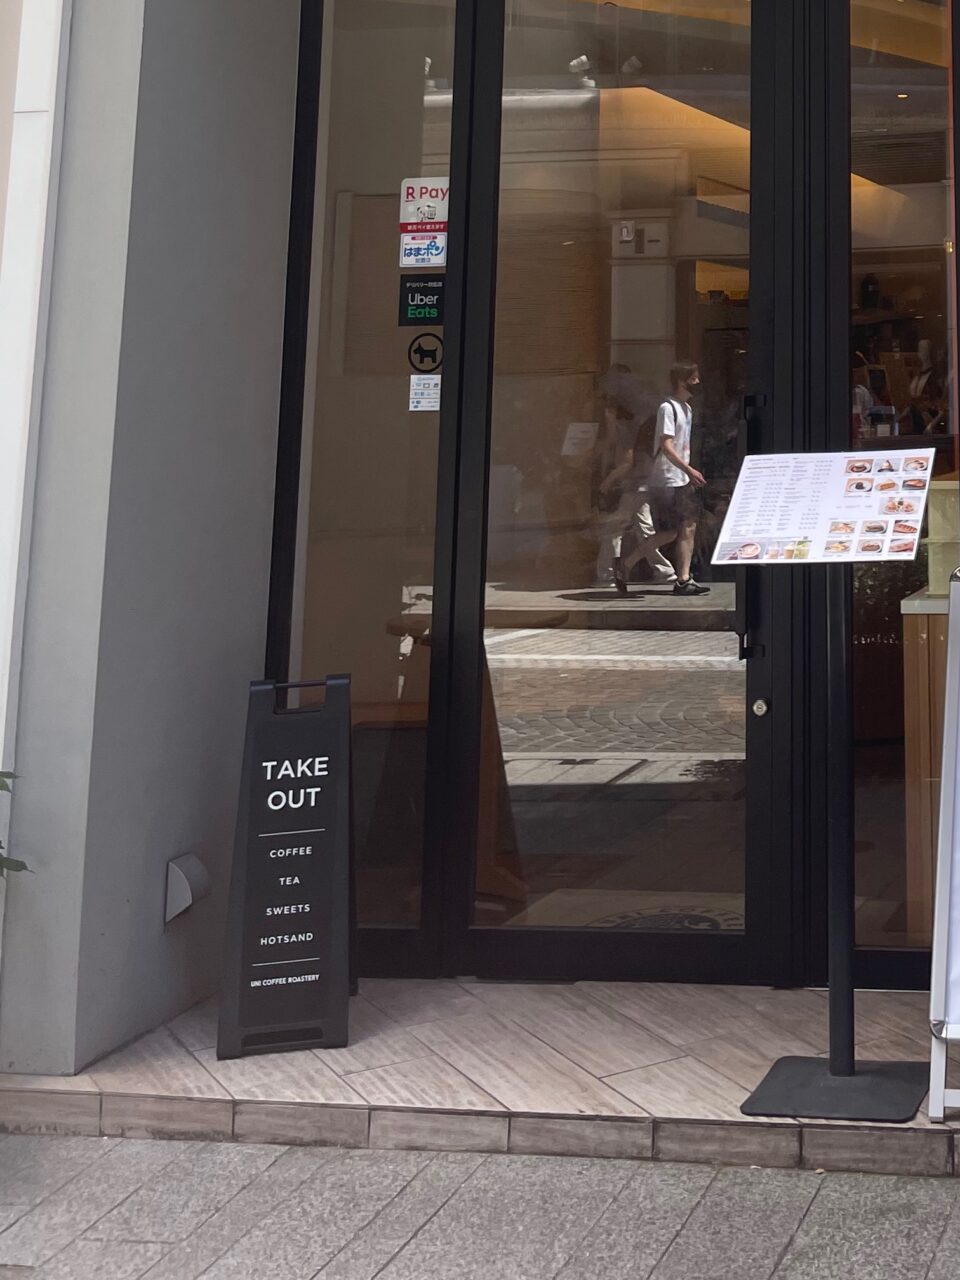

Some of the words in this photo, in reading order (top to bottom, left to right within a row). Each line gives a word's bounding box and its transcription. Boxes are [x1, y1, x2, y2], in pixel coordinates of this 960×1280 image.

[420, 186, 449, 201] Pay
[404, 240, 445, 258] はまポン
[408, 293, 439, 305] Uber
[408, 306, 438, 318] Eats
[262, 756, 329, 780] TAKE
[267, 787, 321, 811] OUT
[269, 846, 313, 858] COFFEE
[279, 876, 301, 886] TEA
[266, 904, 311, 916] SWEETS
[260, 932, 314, 945] HOTSAND
[262, 977, 287, 986] COFFEE
[288, 974, 320, 984] ROASTERY
